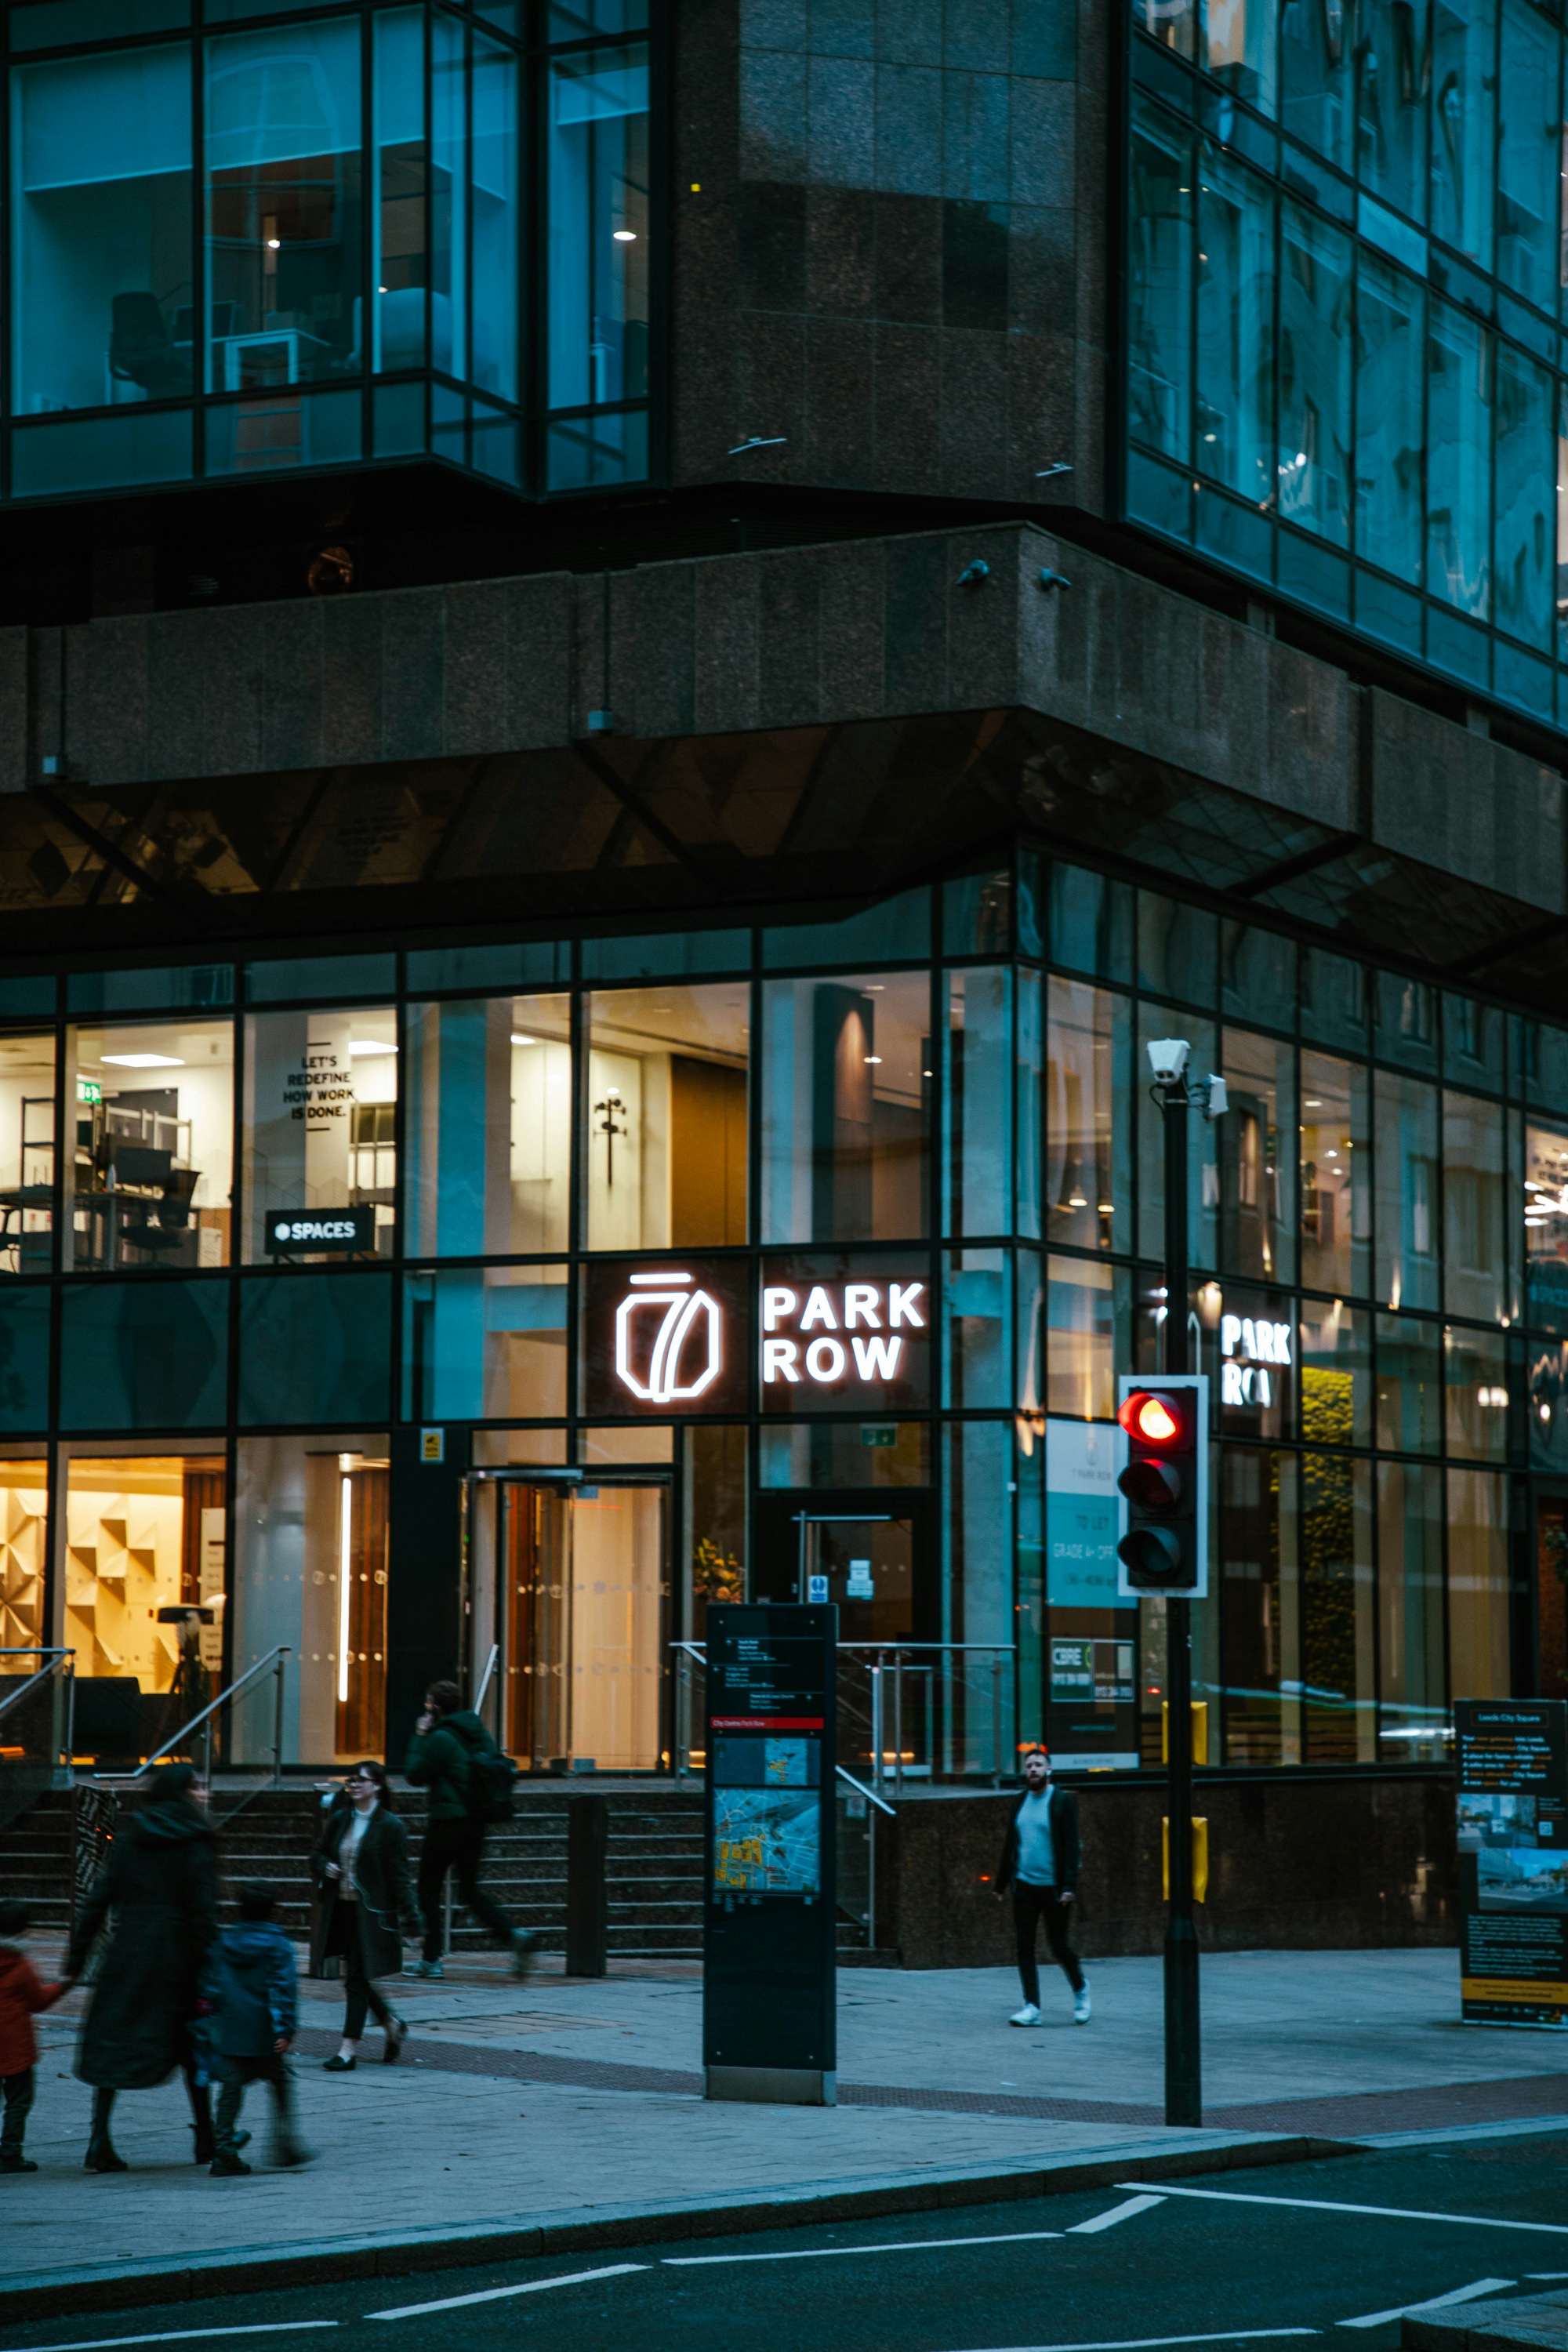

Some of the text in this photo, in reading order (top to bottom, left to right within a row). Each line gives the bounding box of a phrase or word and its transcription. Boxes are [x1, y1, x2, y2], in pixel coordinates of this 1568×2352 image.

[302, 1056, 337, 1068] LET'S
[288, 1072, 351, 1085] REDEFINE
[283, 1088, 355, 1102] HOW WORK
[292, 1109, 303, 1119] IS
[291, 1221, 356, 1239] SPACES
[764, 1283, 925, 1330] PARK
[1221, 1314, 1291, 1365] PARK
[764, 1336, 902, 1382] ROW
